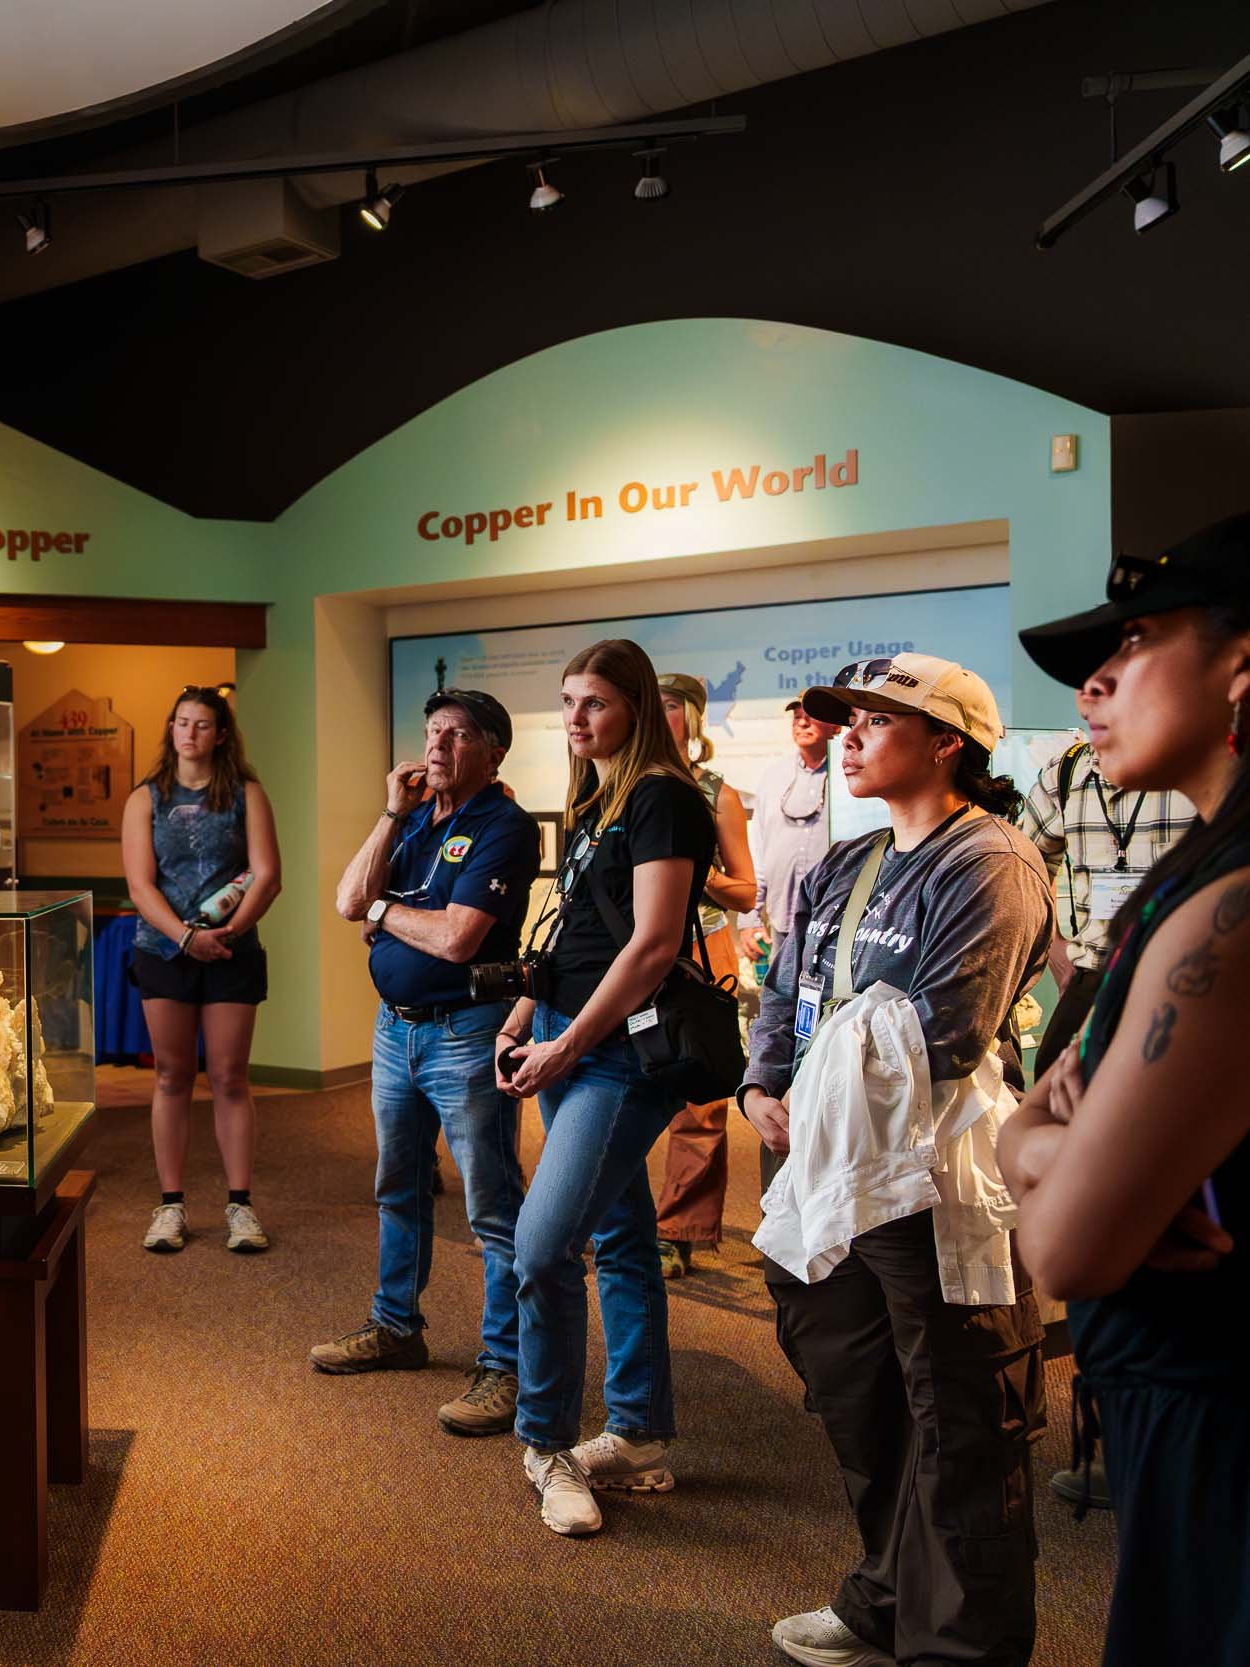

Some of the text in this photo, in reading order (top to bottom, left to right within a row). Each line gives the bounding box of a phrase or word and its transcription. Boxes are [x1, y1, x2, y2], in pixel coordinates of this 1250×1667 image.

[417, 448, 859, 545] Copper In Our World
[764, 640, 914, 665] Copper Usage
[778, 673, 798, 690] In
[855, 926, 914, 954] ountry
